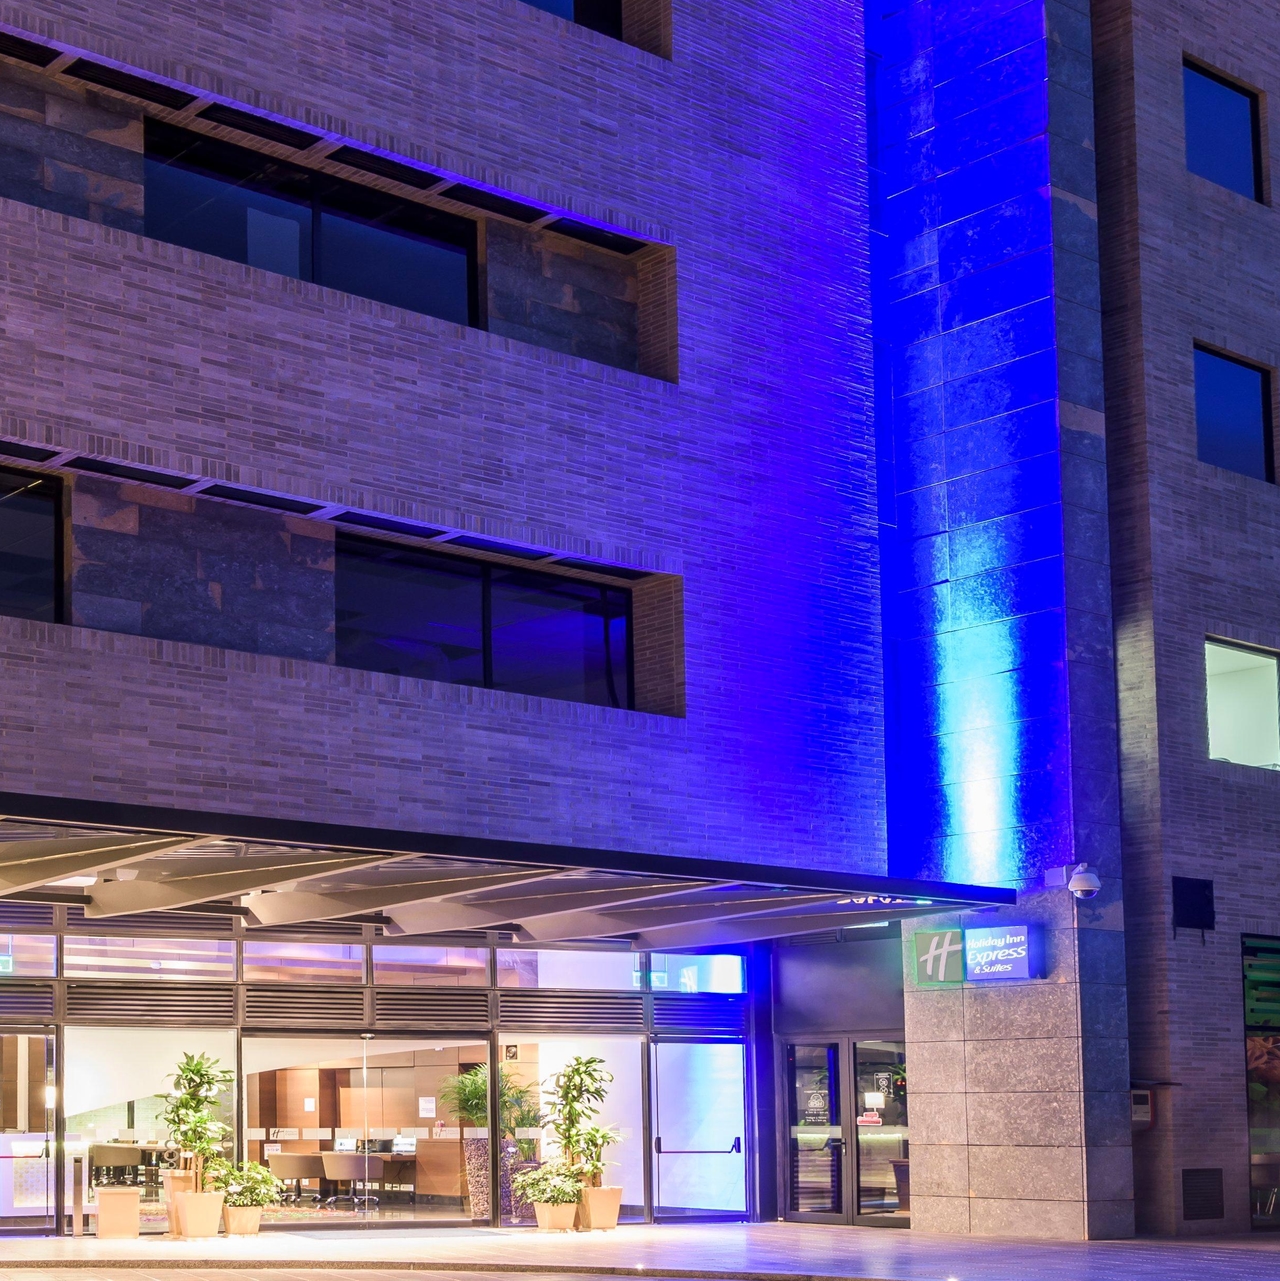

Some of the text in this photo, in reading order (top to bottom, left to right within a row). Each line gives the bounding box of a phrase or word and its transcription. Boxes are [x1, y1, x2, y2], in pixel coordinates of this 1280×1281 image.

[966, 934, 1025, 949] Holiday Inn
[967, 946, 1026, 965] Express
[973, 963, 1013, 974] & Suites
